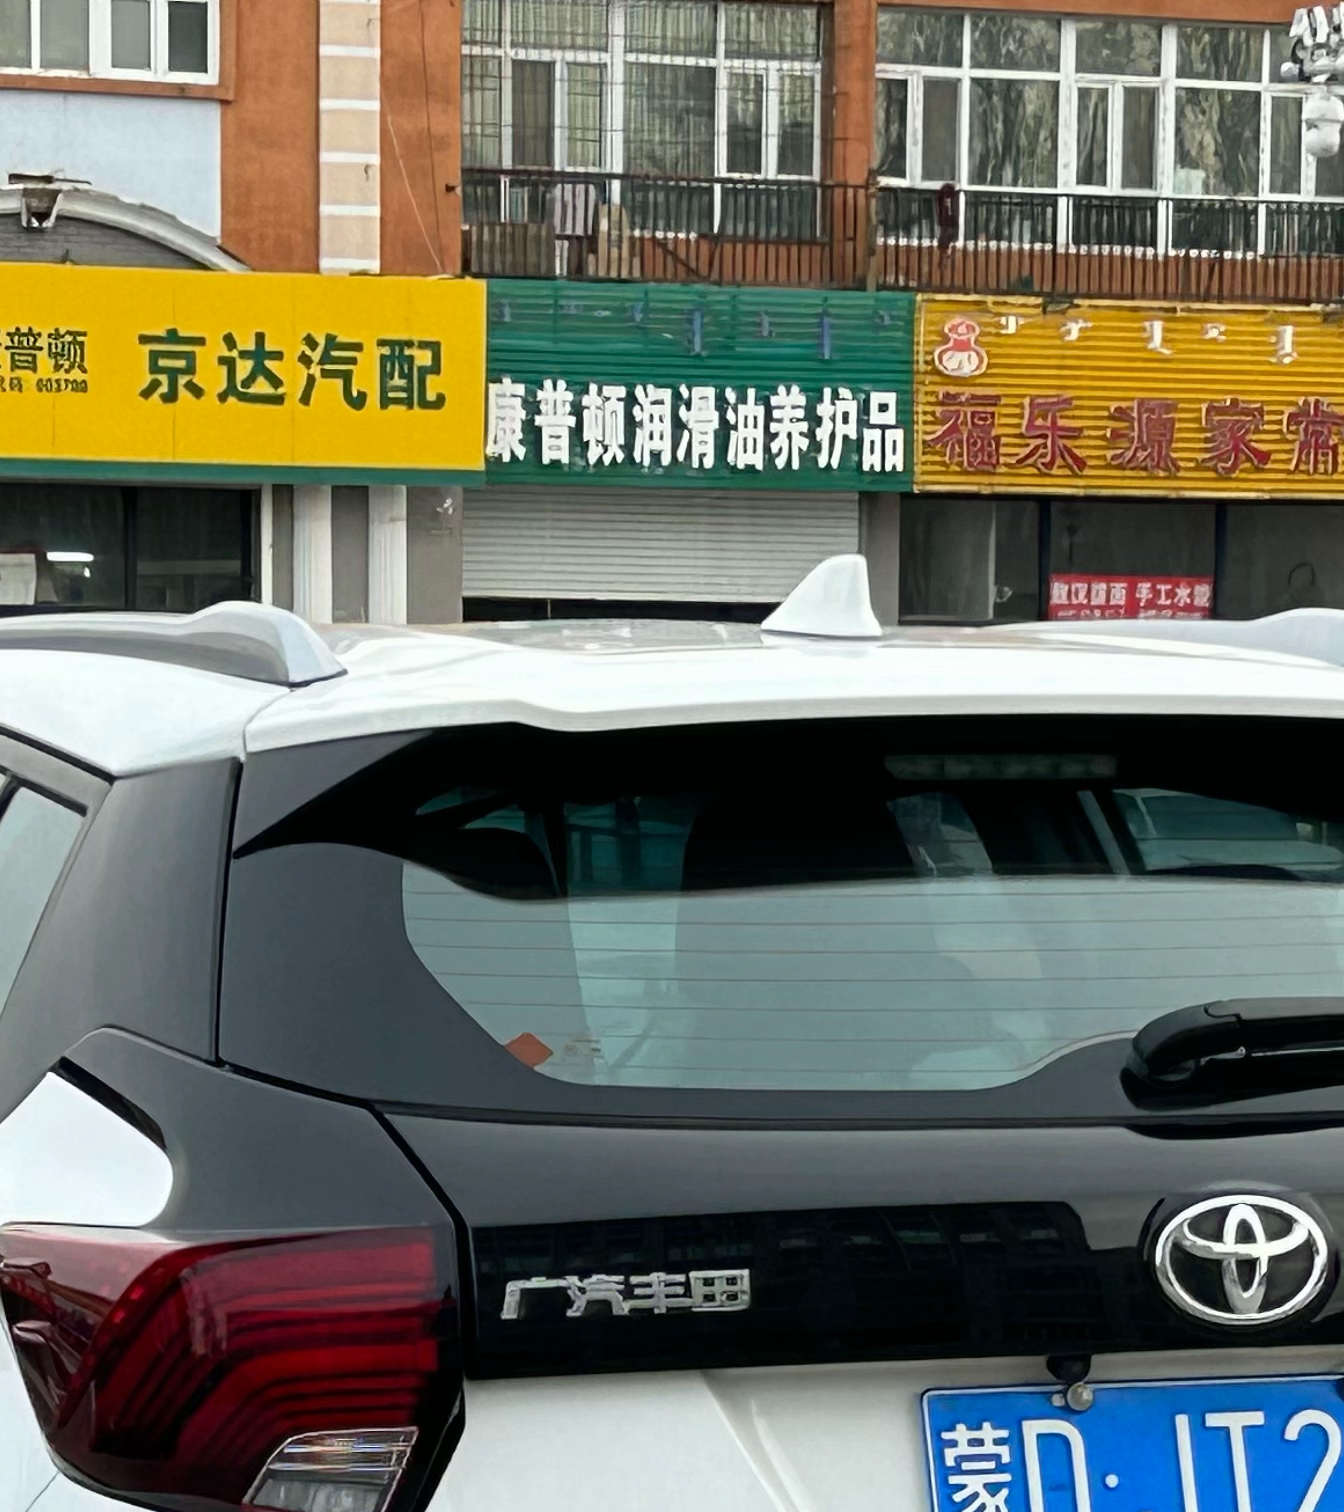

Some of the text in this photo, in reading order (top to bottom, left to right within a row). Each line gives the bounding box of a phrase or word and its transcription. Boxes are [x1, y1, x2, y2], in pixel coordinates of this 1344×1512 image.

[137, 327, 447, 412] 京达汽配
[485, 376, 905, 473] 康普顿润滑油养护品
[499, 1267, 752, 1321] 广汽丰田
